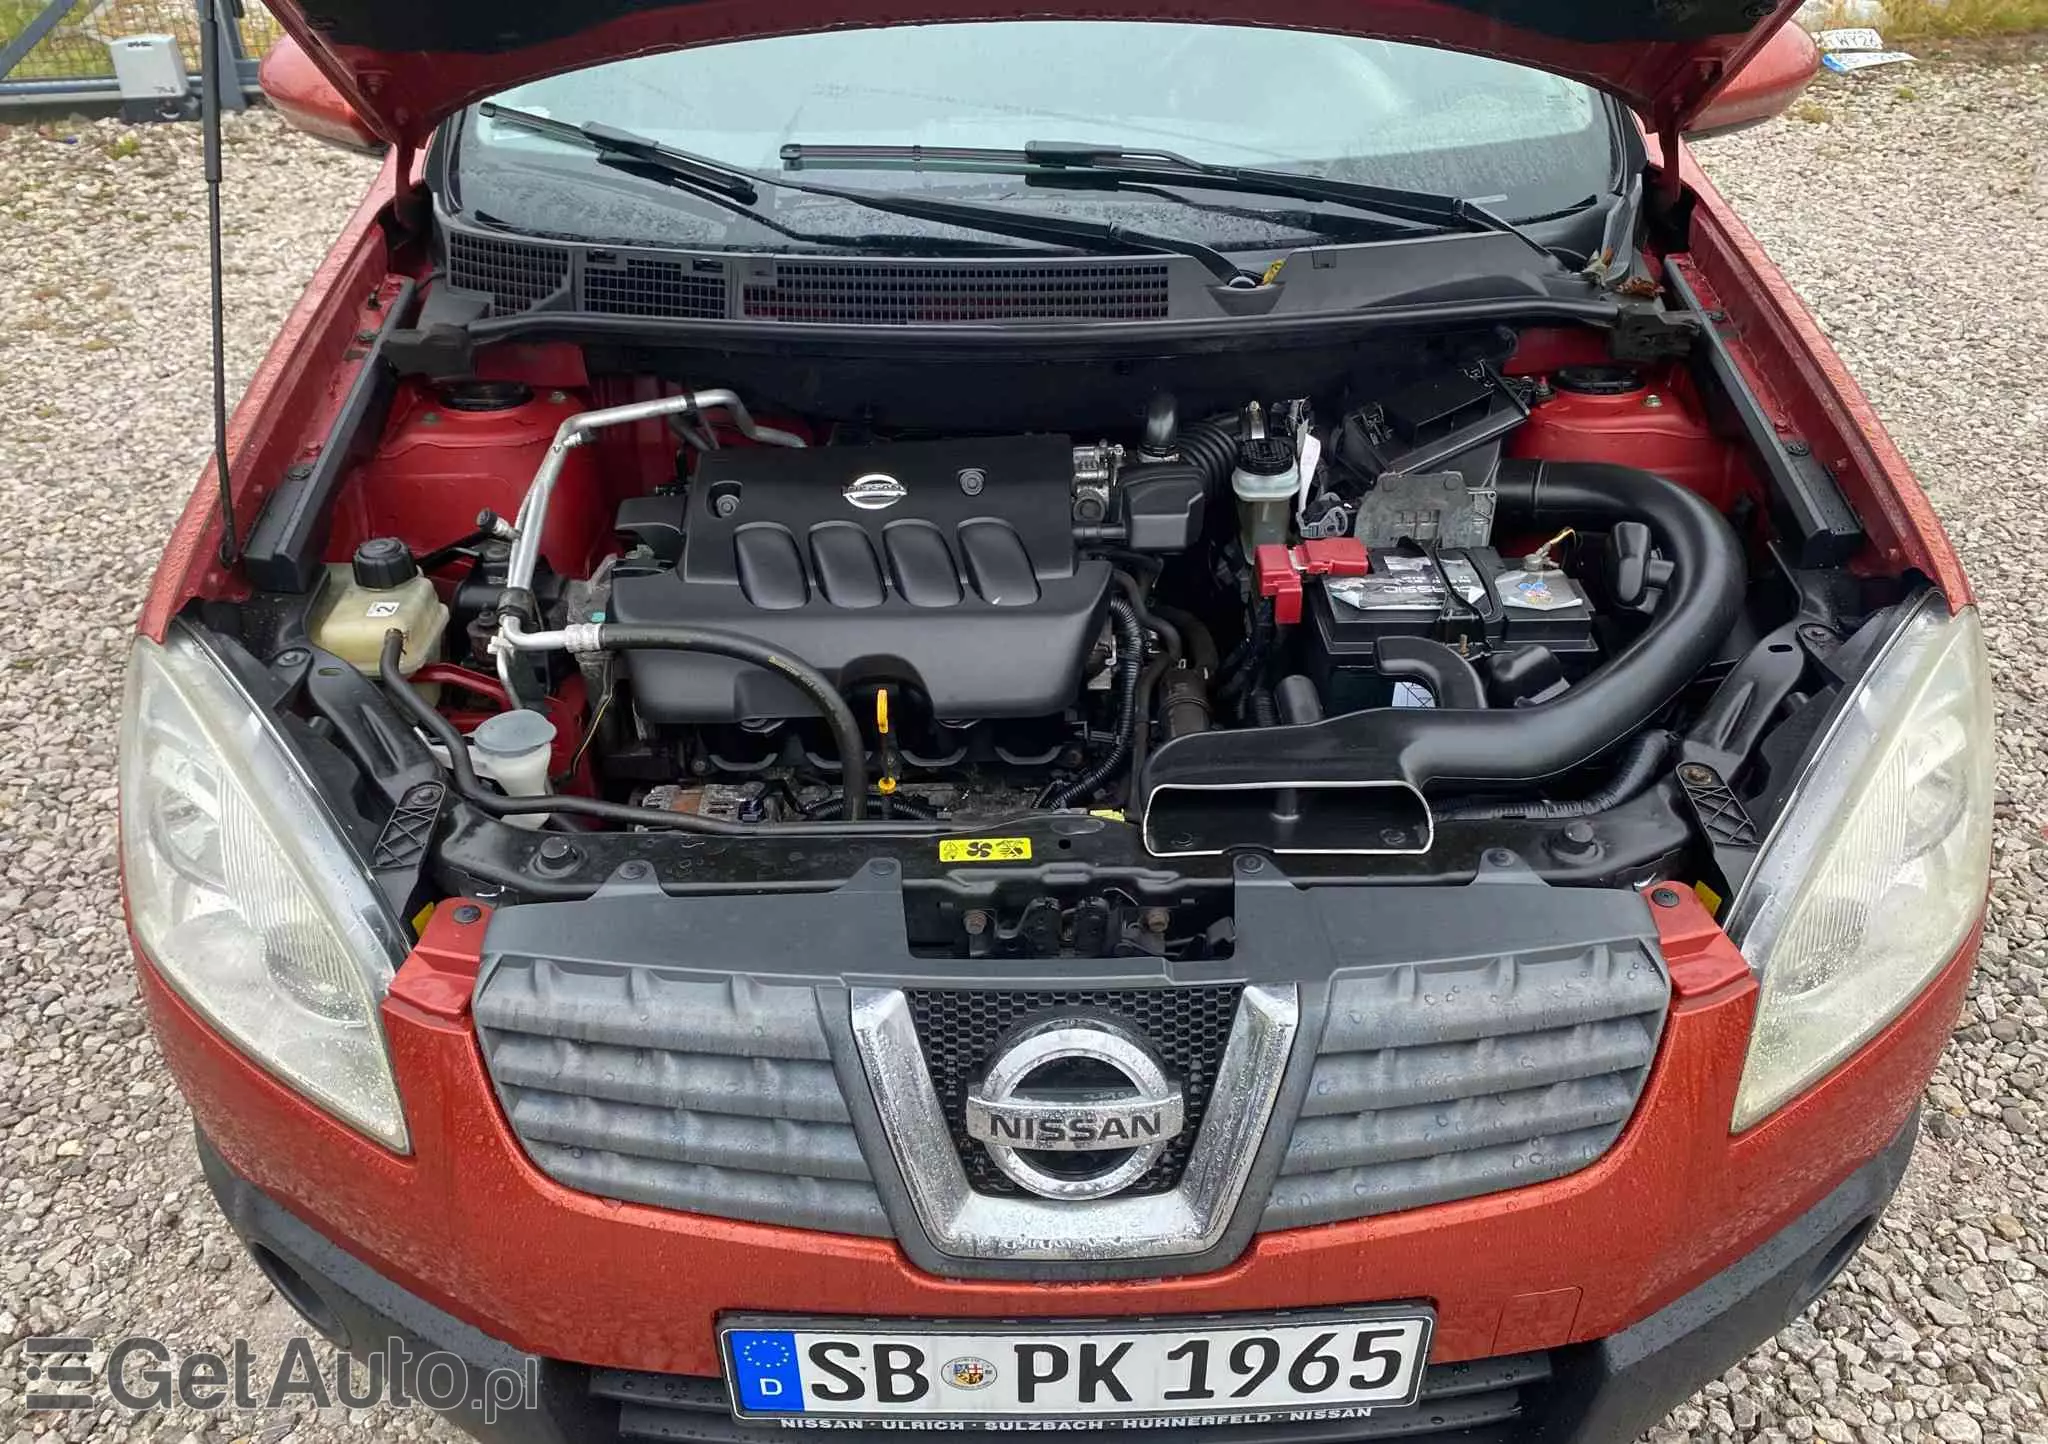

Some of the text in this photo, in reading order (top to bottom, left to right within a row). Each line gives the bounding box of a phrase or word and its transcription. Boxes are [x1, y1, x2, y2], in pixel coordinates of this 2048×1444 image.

[989, 1111, 1161, 1142] NISSAN
[808, 1328, 1405, 1403] SB PK 1965
[759, 1377, 784, 1396] D
[779, 1418, 863, 1430] NISSAN
[881, 1419, 964, 1431] ULRICH
[983, 1417, 1103, 1432] SULZBACH
[1289, 1406, 1372, 1421] NISSAN
